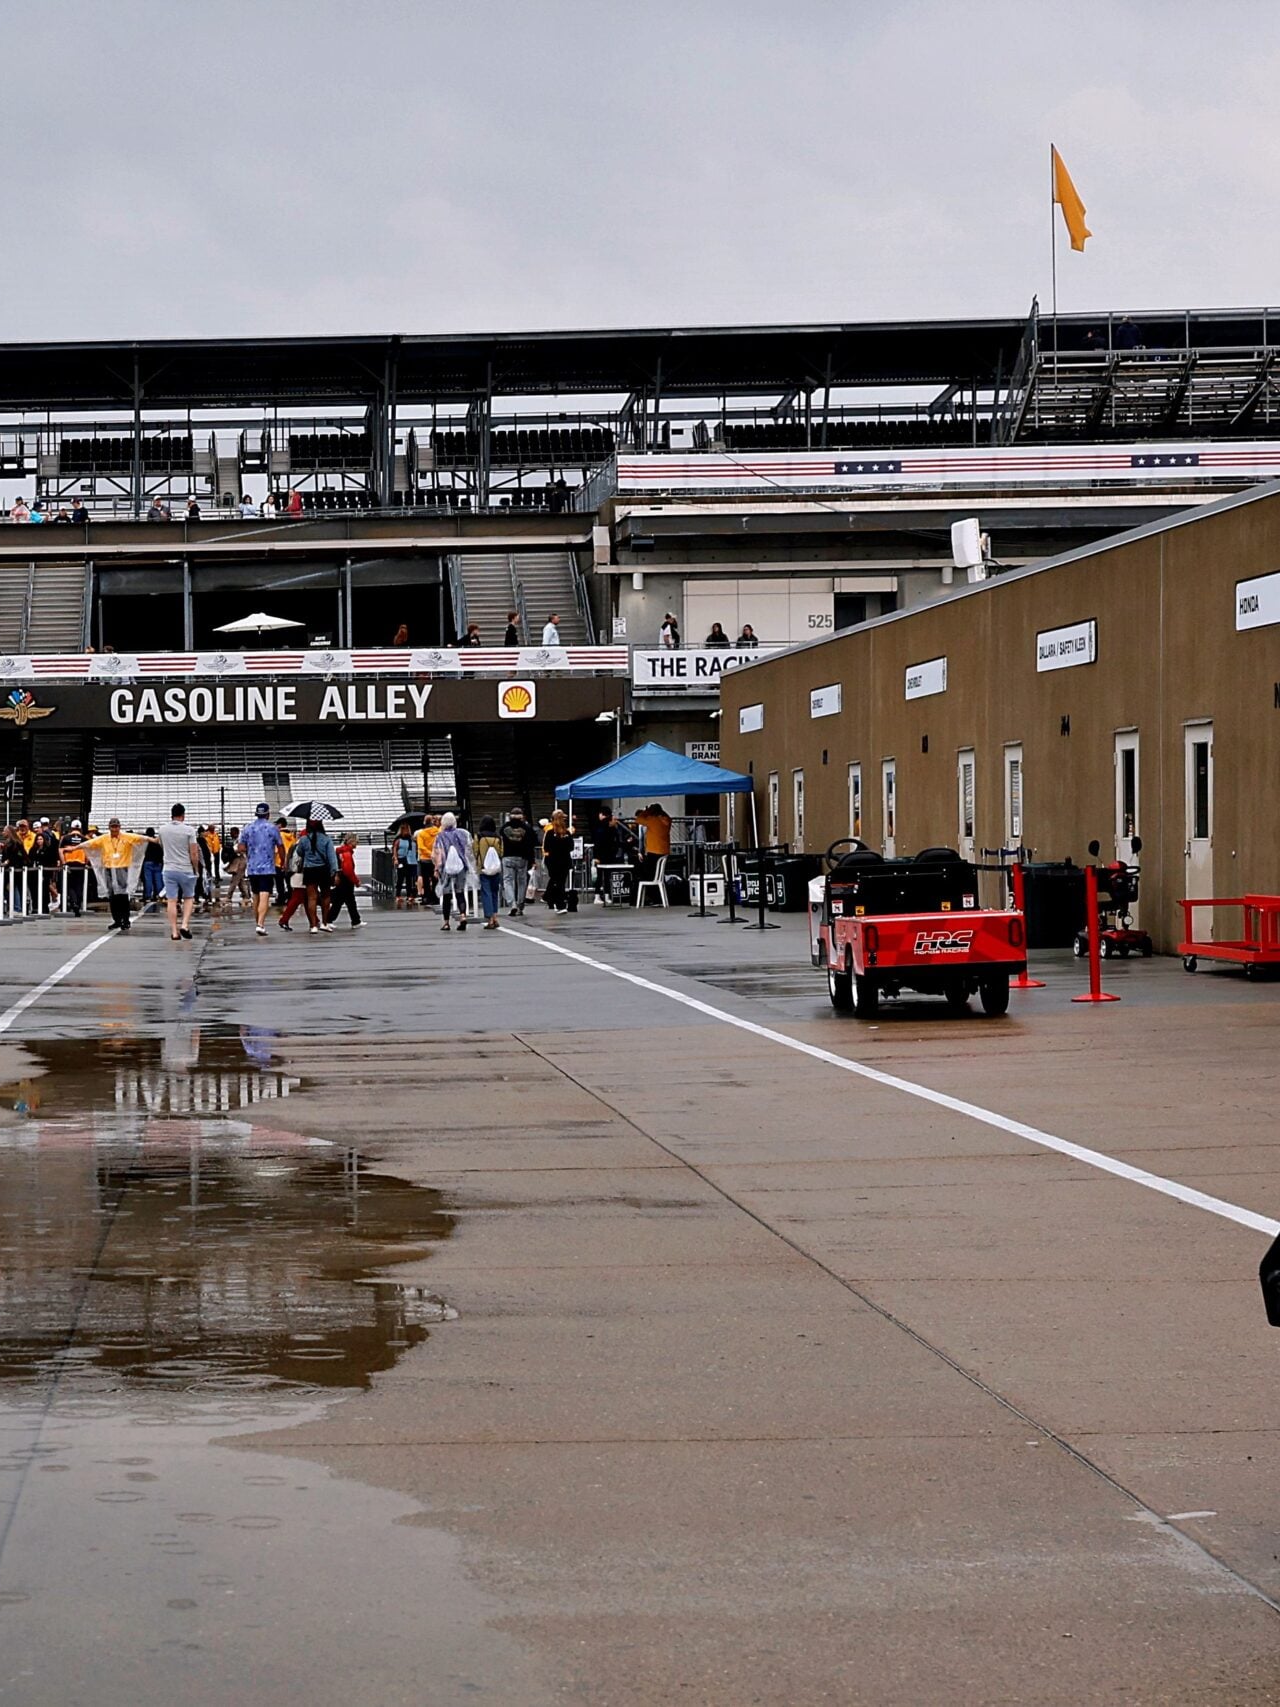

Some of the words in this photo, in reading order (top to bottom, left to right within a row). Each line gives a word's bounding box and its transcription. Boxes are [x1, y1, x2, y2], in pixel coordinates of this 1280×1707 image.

[1239, 595, 1259, 615] HONDA
[808, 614, 833, 629] 525
[647, 657, 687, 678] THE
[110, 685, 297, 723] GASOLINE
[319, 684, 433, 721] ALLEY
[691, 743, 707, 751] PIT
[708, 743, 720, 751] RO
[913, 930, 974, 951] HRC
